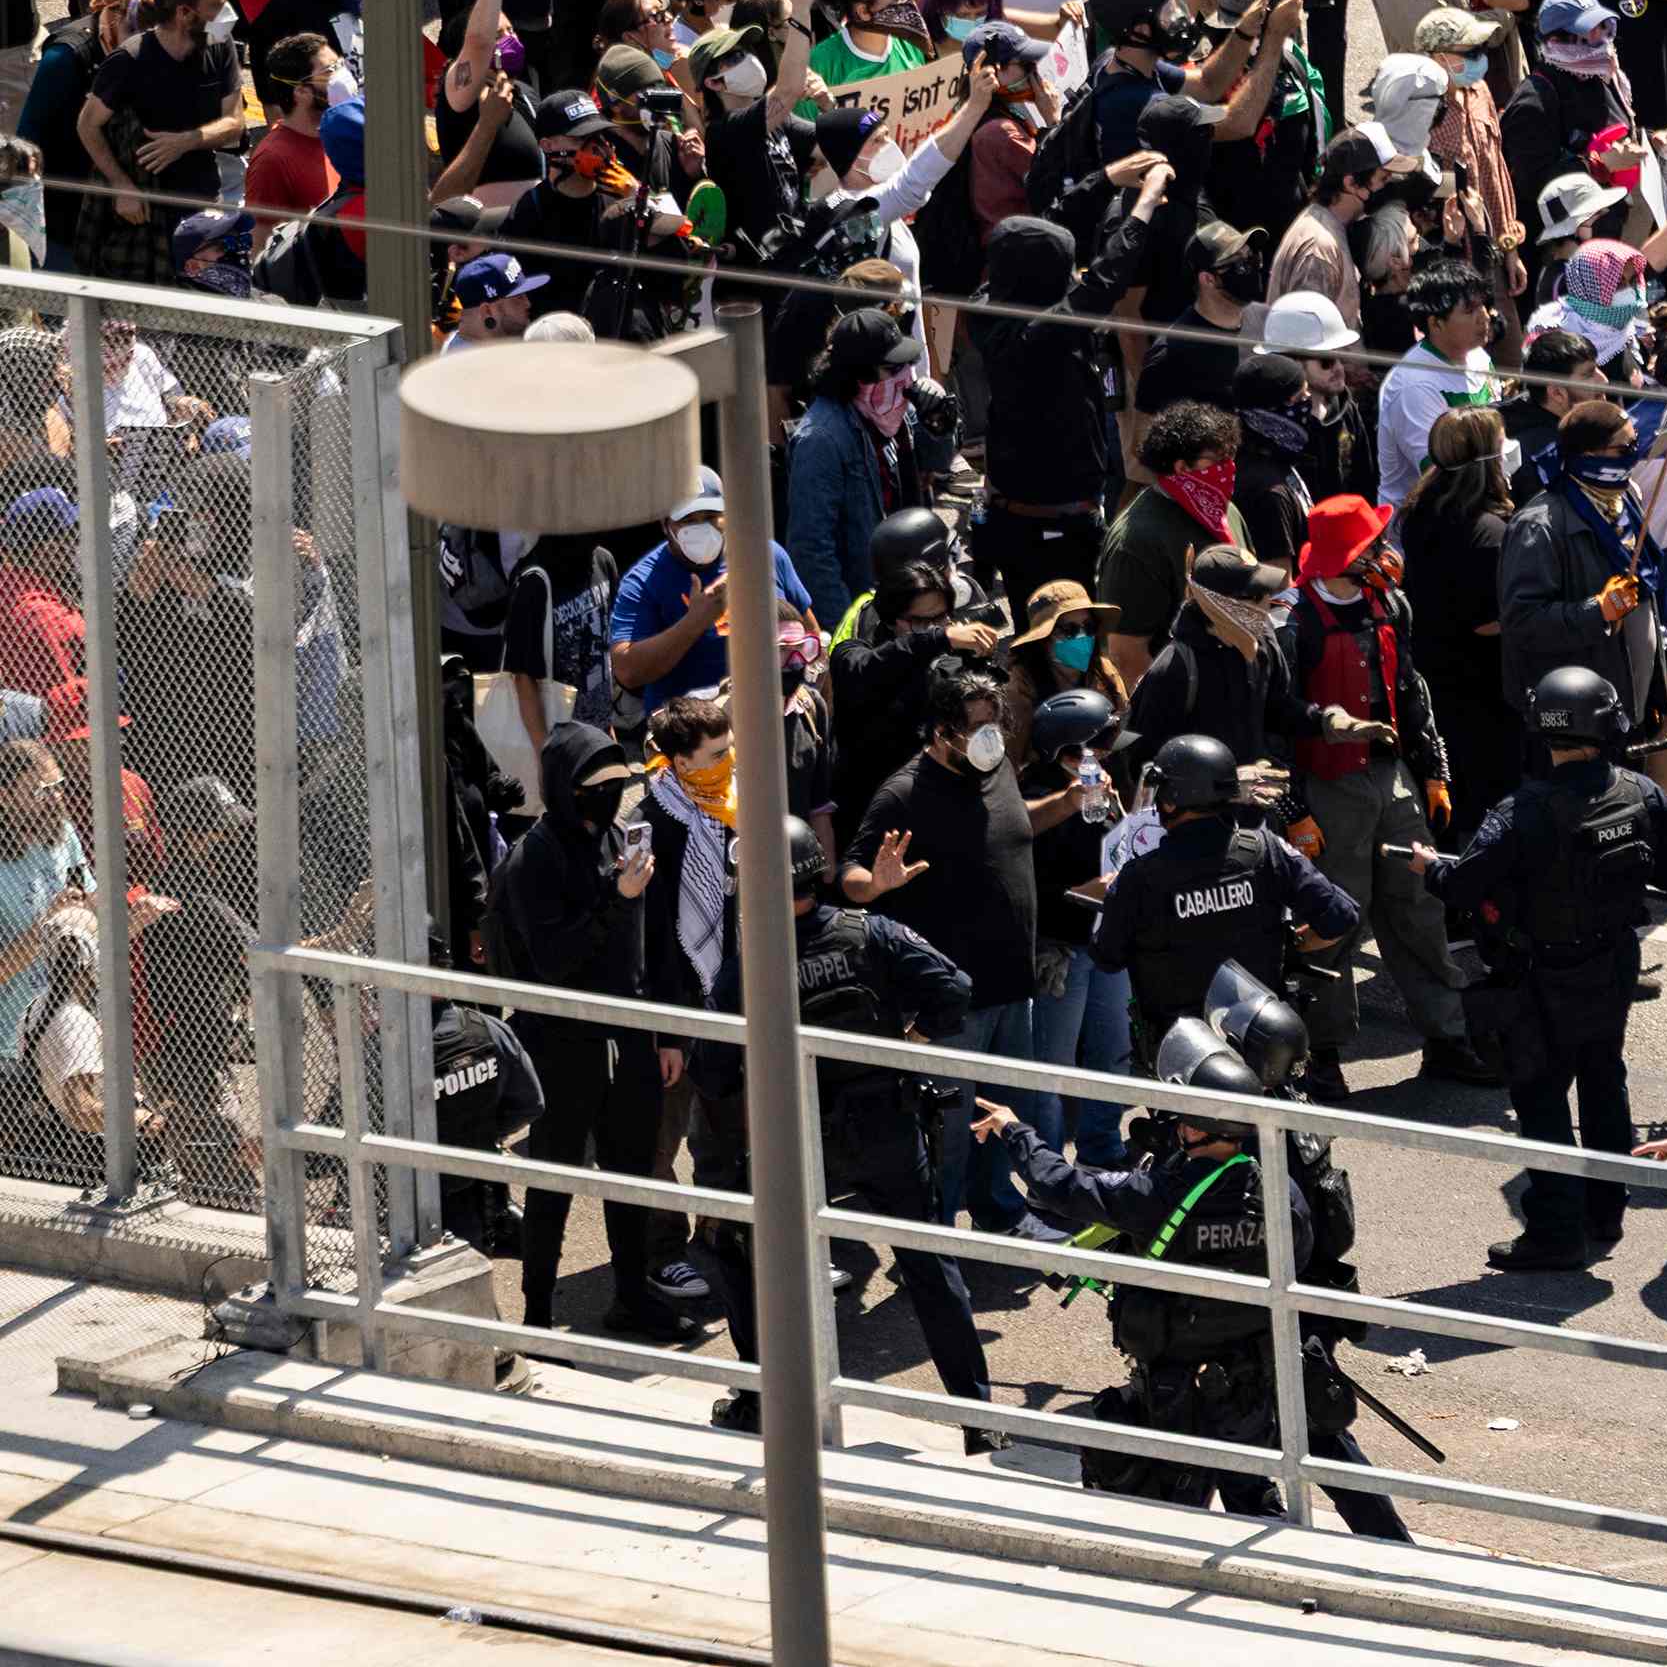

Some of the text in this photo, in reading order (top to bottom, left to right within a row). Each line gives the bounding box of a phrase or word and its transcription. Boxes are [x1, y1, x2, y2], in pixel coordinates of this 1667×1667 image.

[1598, 823, 1633, 843] POLICE
[1175, 881, 1254, 919] CABALLERO
[433, 1057, 500, 1102] POLICE
